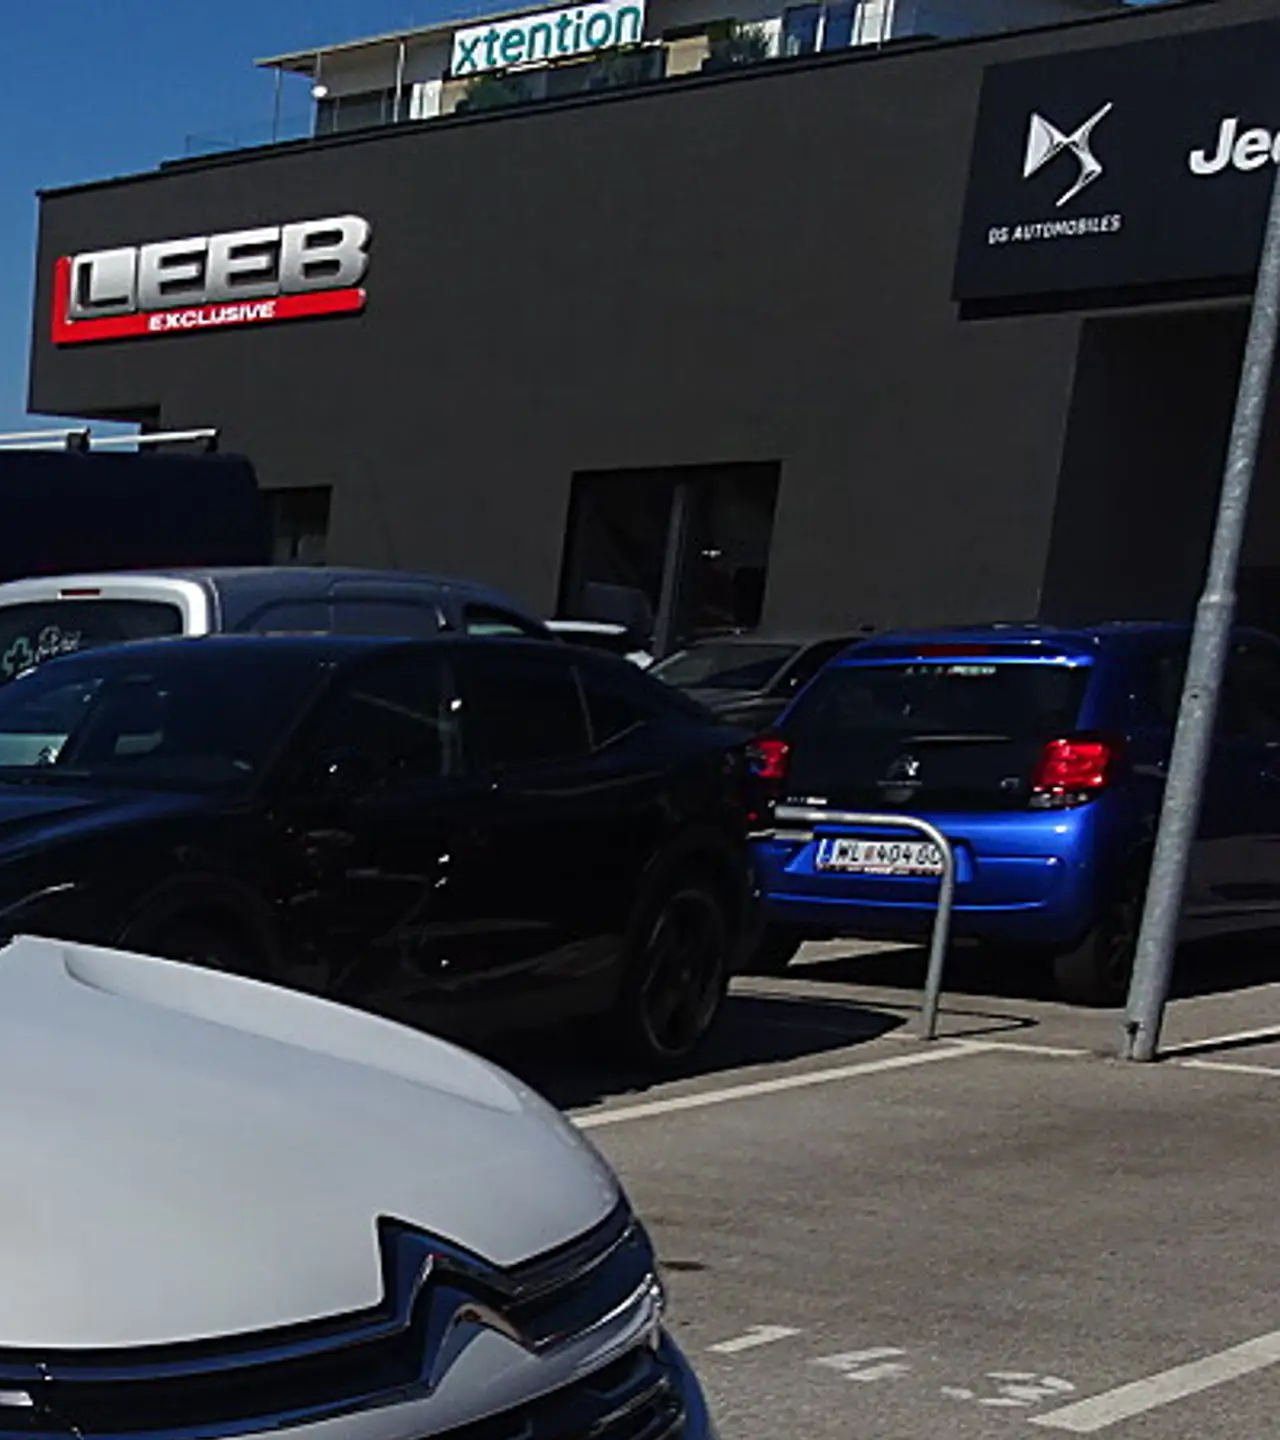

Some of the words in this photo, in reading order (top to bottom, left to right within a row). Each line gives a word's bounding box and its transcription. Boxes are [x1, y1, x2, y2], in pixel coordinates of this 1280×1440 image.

[455, 5, 642, 74] xtention
[1189, 117, 1280, 175] Je
[1011, 214, 1122, 241] AUTOMOBILES
[69, 214, 371, 319] LEEB
[148, 301, 277, 332] EXCLUSIVE
